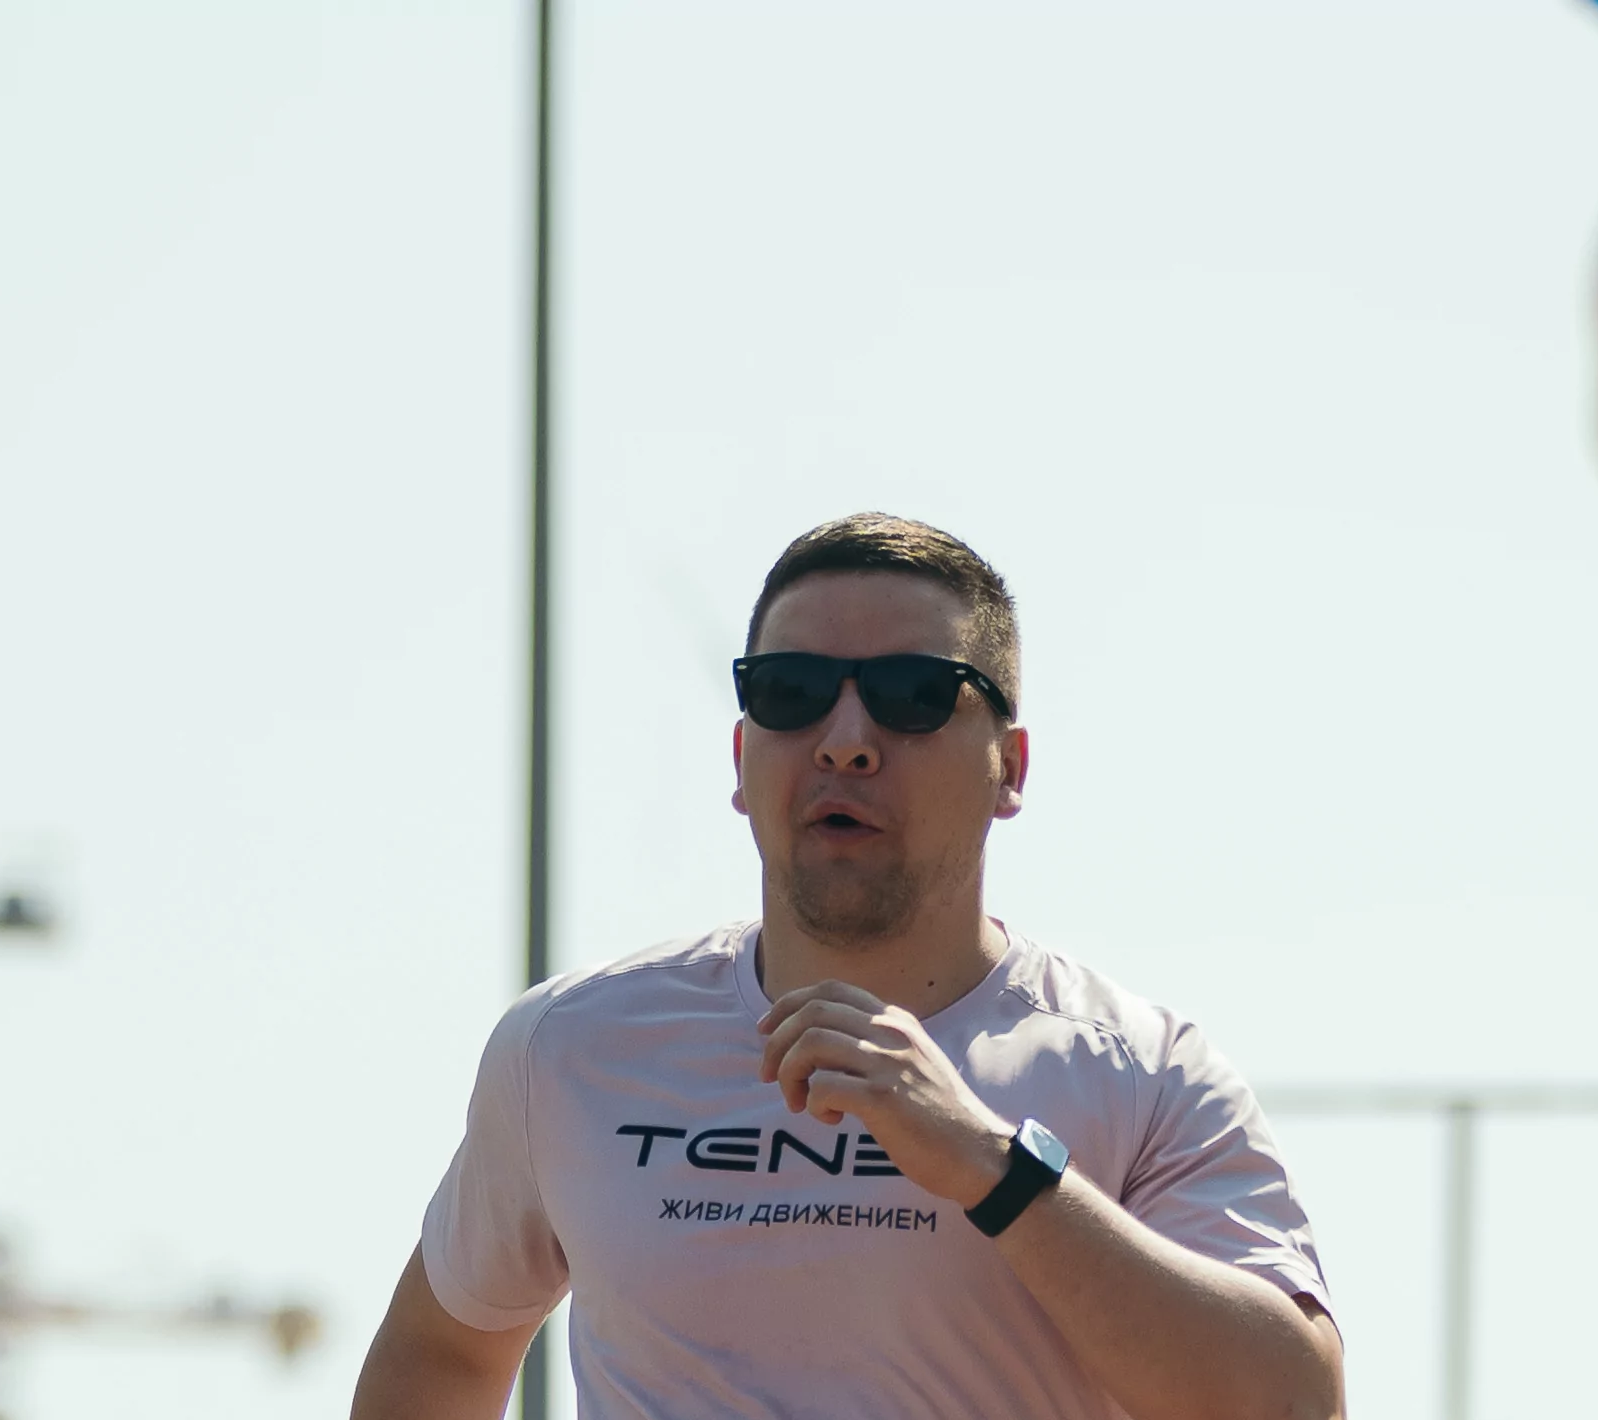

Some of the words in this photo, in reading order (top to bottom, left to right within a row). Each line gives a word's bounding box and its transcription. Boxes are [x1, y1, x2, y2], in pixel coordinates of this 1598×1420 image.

[616, 1123, 906, 1178] TENE
[658, 1198, 745, 1223] ЖИВИ
[748, 1203, 938, 1233] ДВИЖЕНИЕМ
